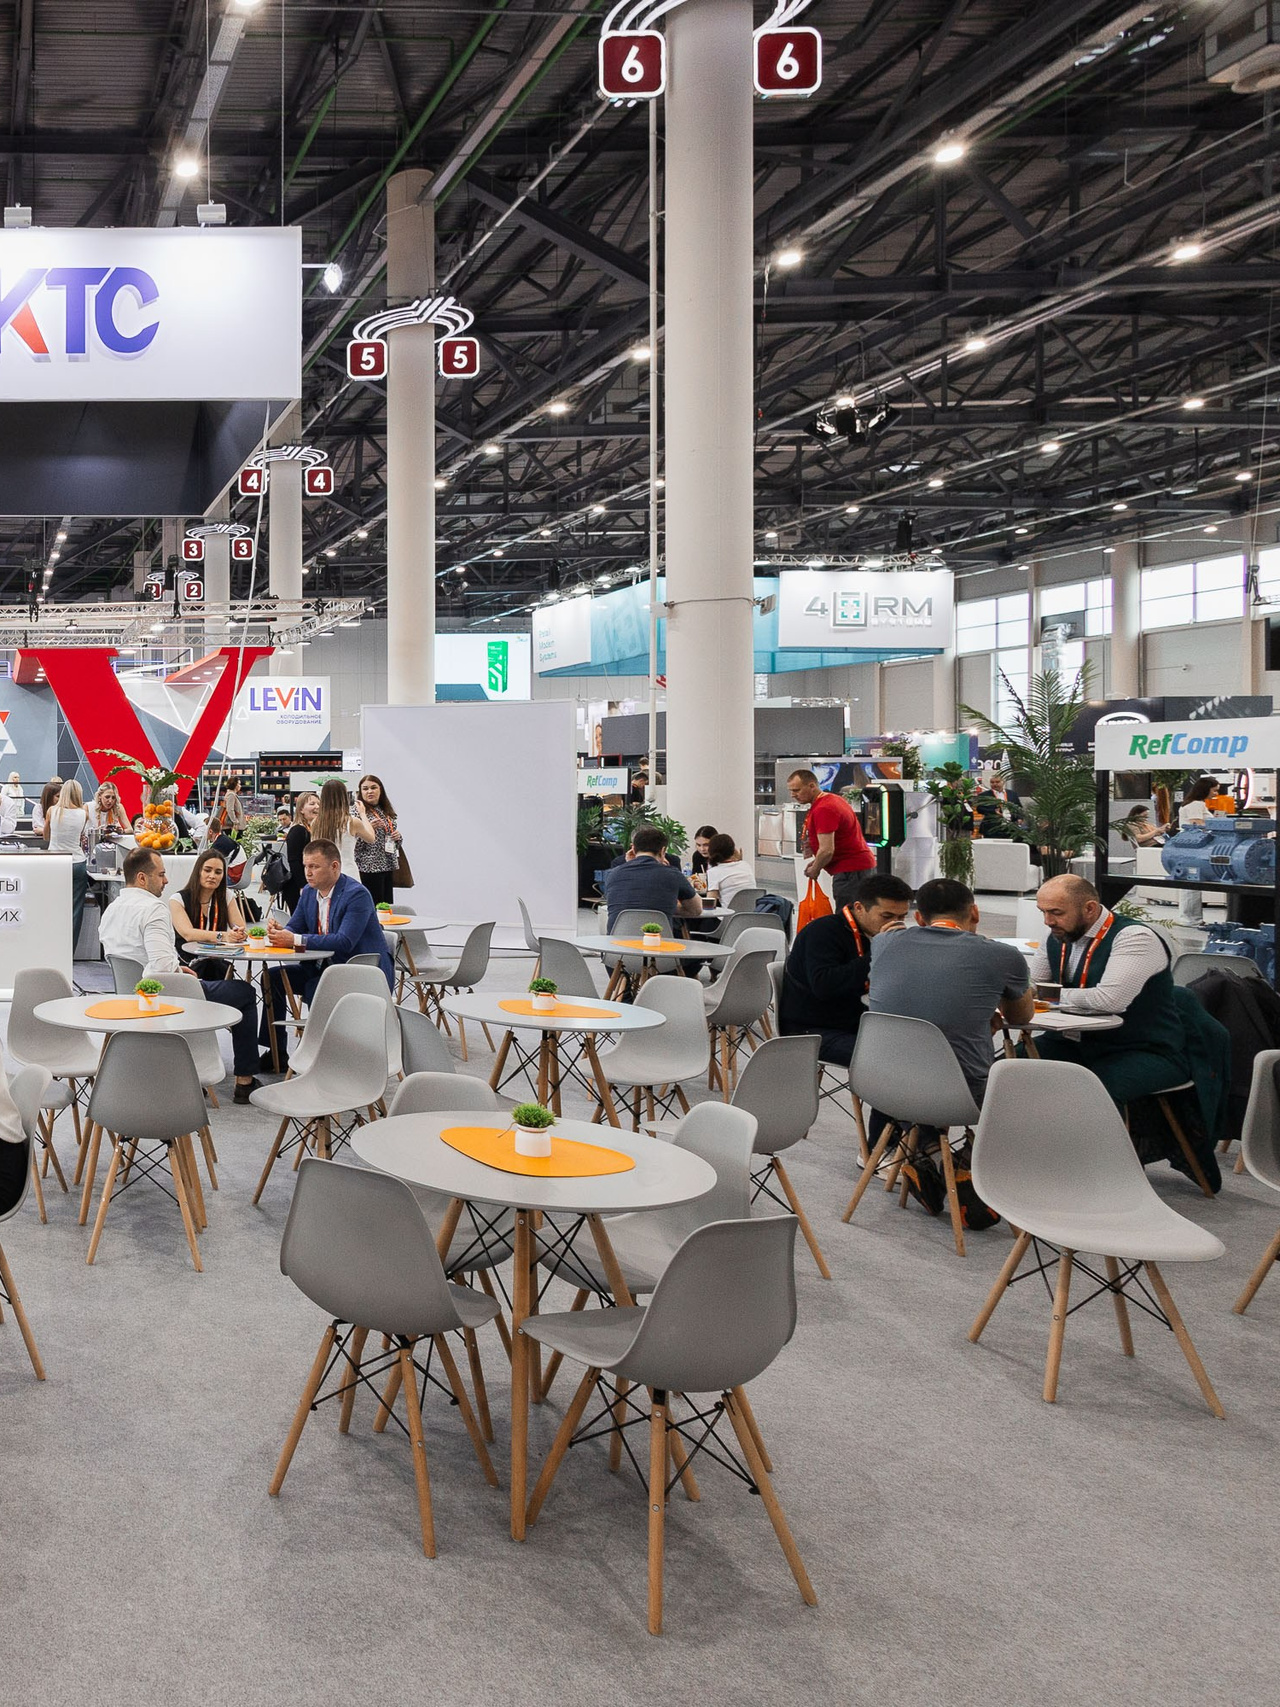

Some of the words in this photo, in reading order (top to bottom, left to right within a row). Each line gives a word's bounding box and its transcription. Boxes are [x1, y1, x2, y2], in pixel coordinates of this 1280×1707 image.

[621, 45, 645, 83] 6
[776, 42, 800, 80] 6
[360, 347, 376, 371] 5
[452, 345, 468, 369] 5
[246, 472, 260, 490] 4
[313, 472, 326, 490] 4
[188, 543, 199, 557] 3
[238, 542, 249, 556] 3
[189, 584, 198, 596] 2
[805, 596, 829, 615] 4
[873, 597, 933, 616] RM
[1128, 733, 1249, 760] RefComp
[586, 775, 618, 789] RefComp
